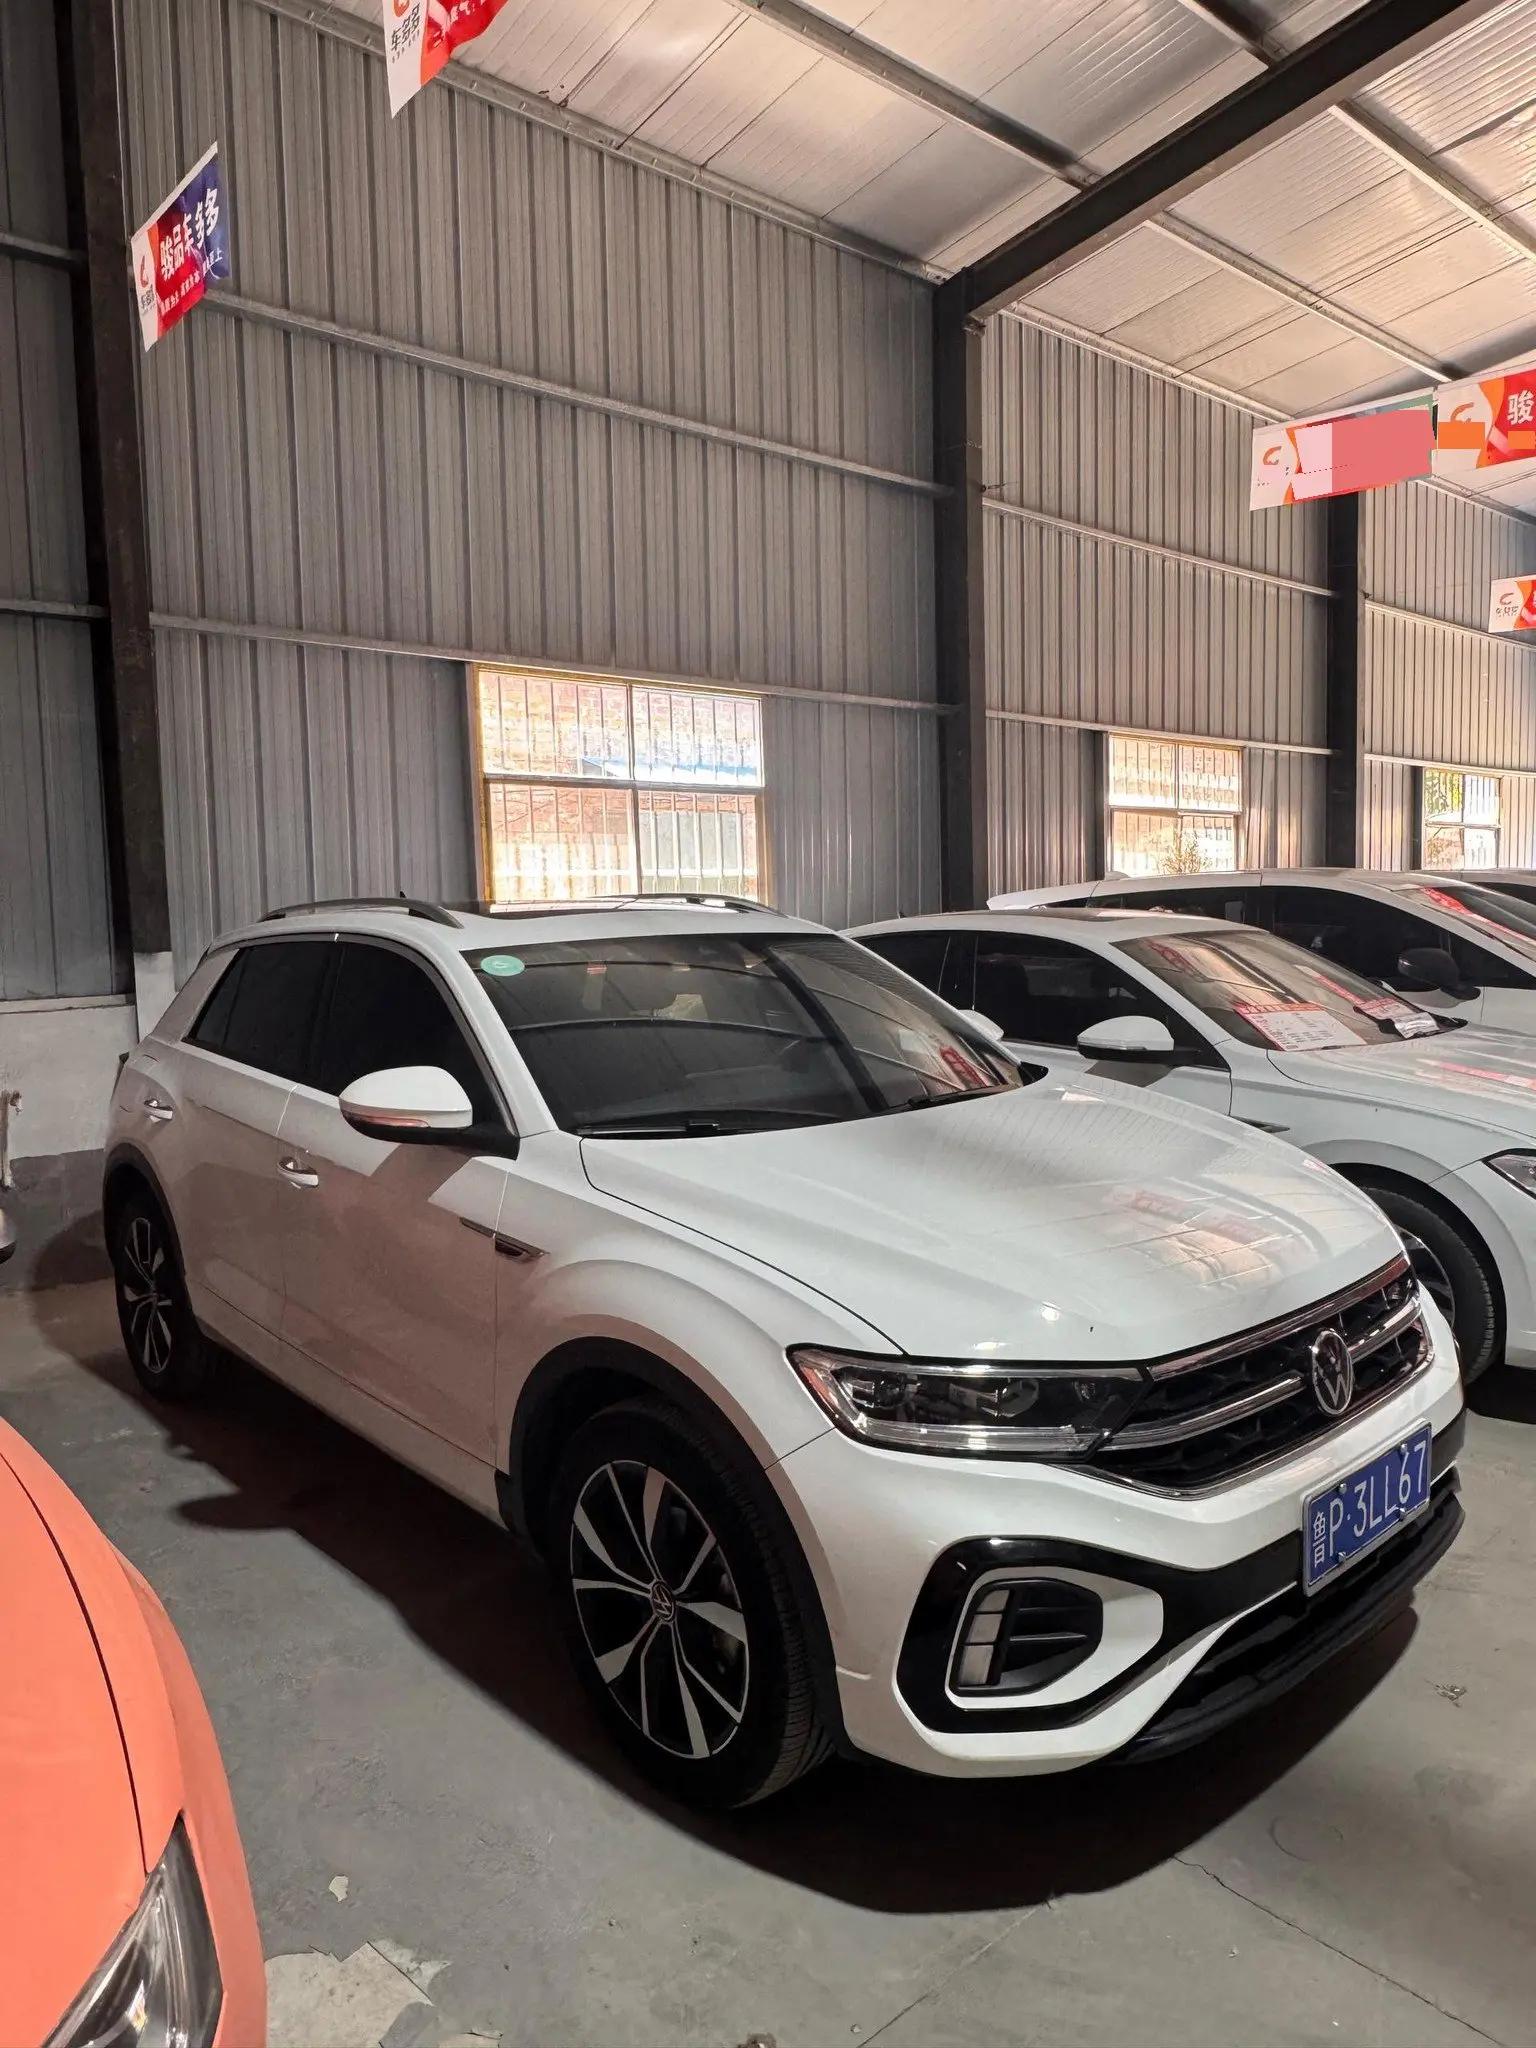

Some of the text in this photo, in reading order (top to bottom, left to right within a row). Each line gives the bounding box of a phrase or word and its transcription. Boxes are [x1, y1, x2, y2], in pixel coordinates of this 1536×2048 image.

[160, 188, 219, 281] 骏品车多多
[1507, 390, 1535, 425] 骏
